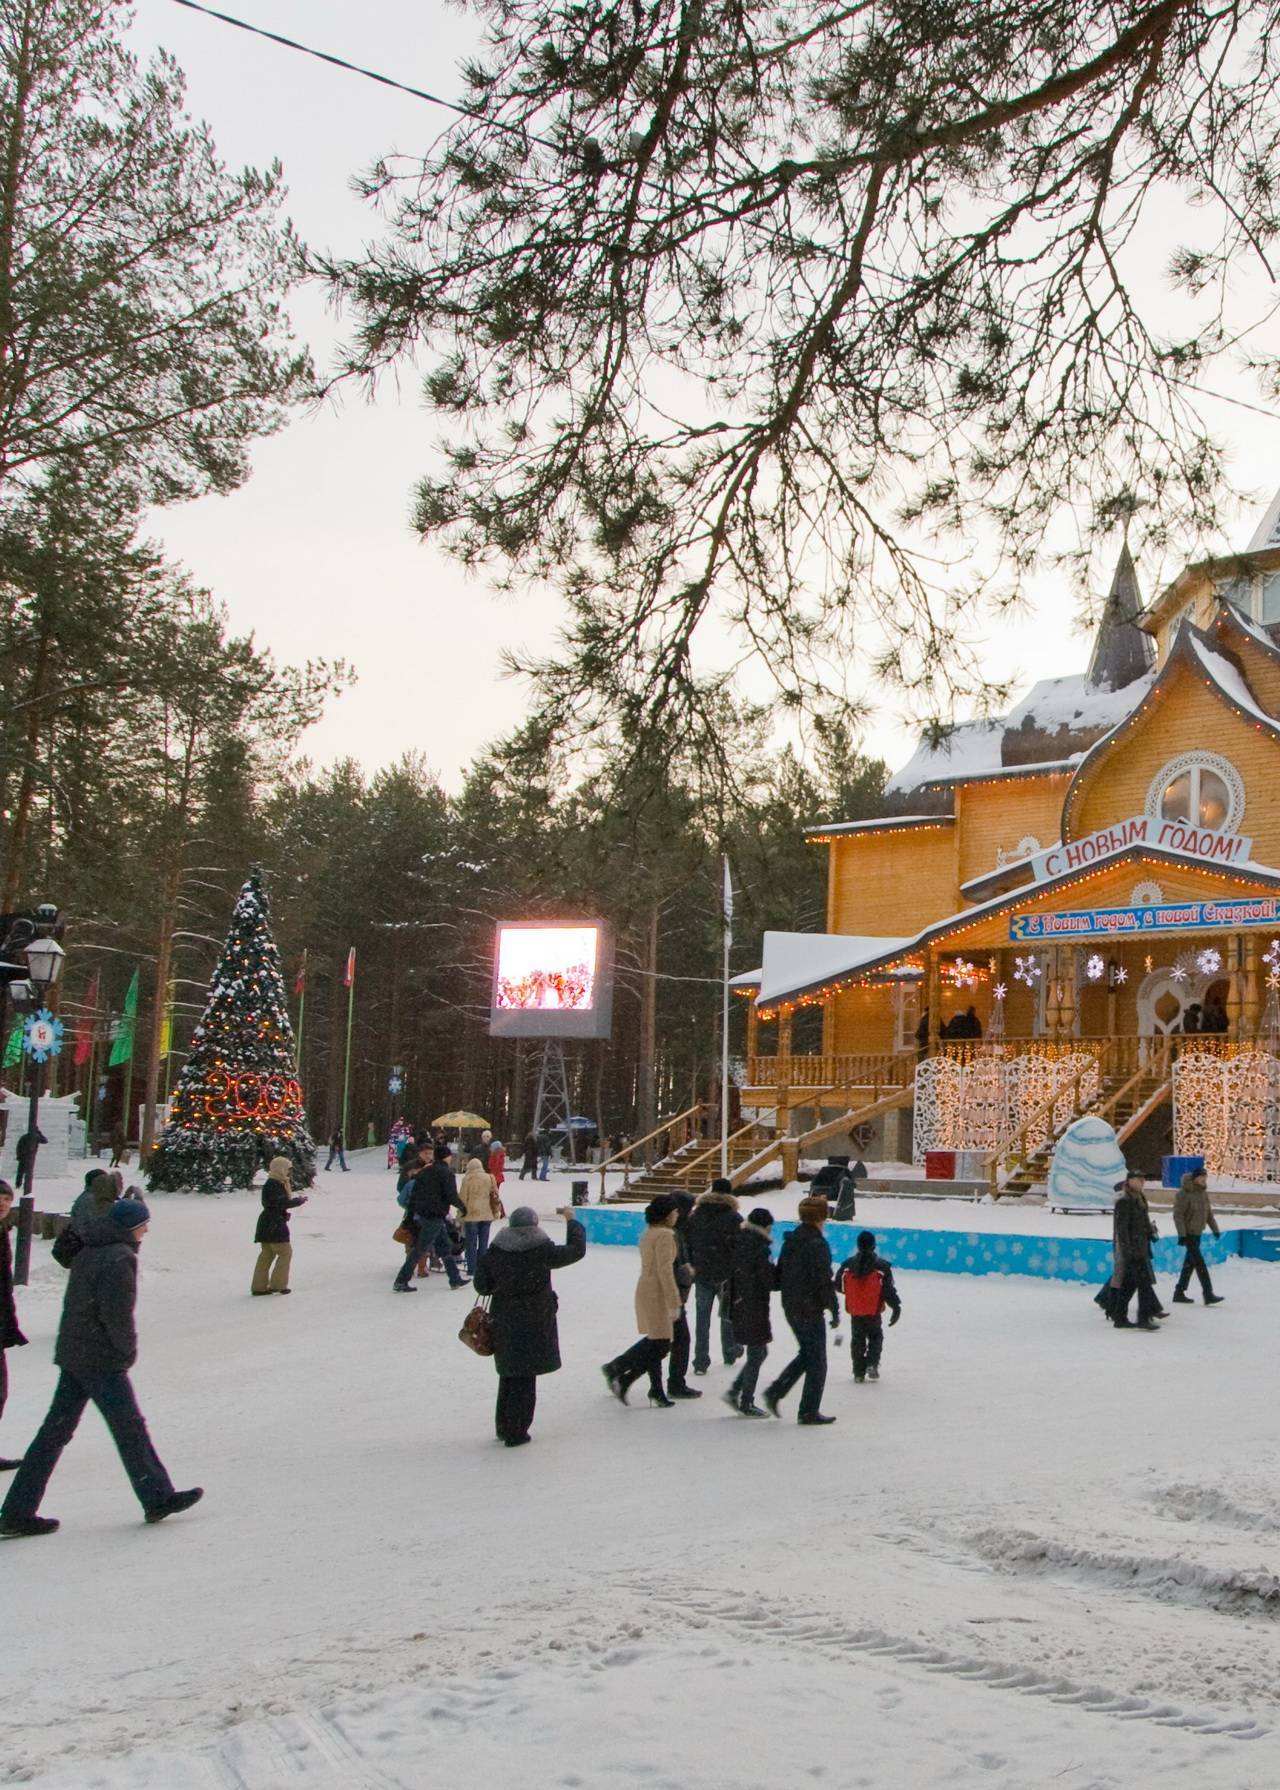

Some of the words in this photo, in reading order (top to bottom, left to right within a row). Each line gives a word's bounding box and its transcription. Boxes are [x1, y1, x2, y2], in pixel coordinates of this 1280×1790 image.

[1045, 854, 1062, 876] С
[1065, 820, 1148, 869] НОВЫМ
[1158, 823, 1243, 862] ГОДОМ!
[1043, 914, 1091, 932] Новым
[1094, 912, 1140, 935] годом,
[1155, 904, 1199, 925] новой
[1203, 899, 1277, 924] Сказкой!
[206, 1070, 304, 1119] 2009
